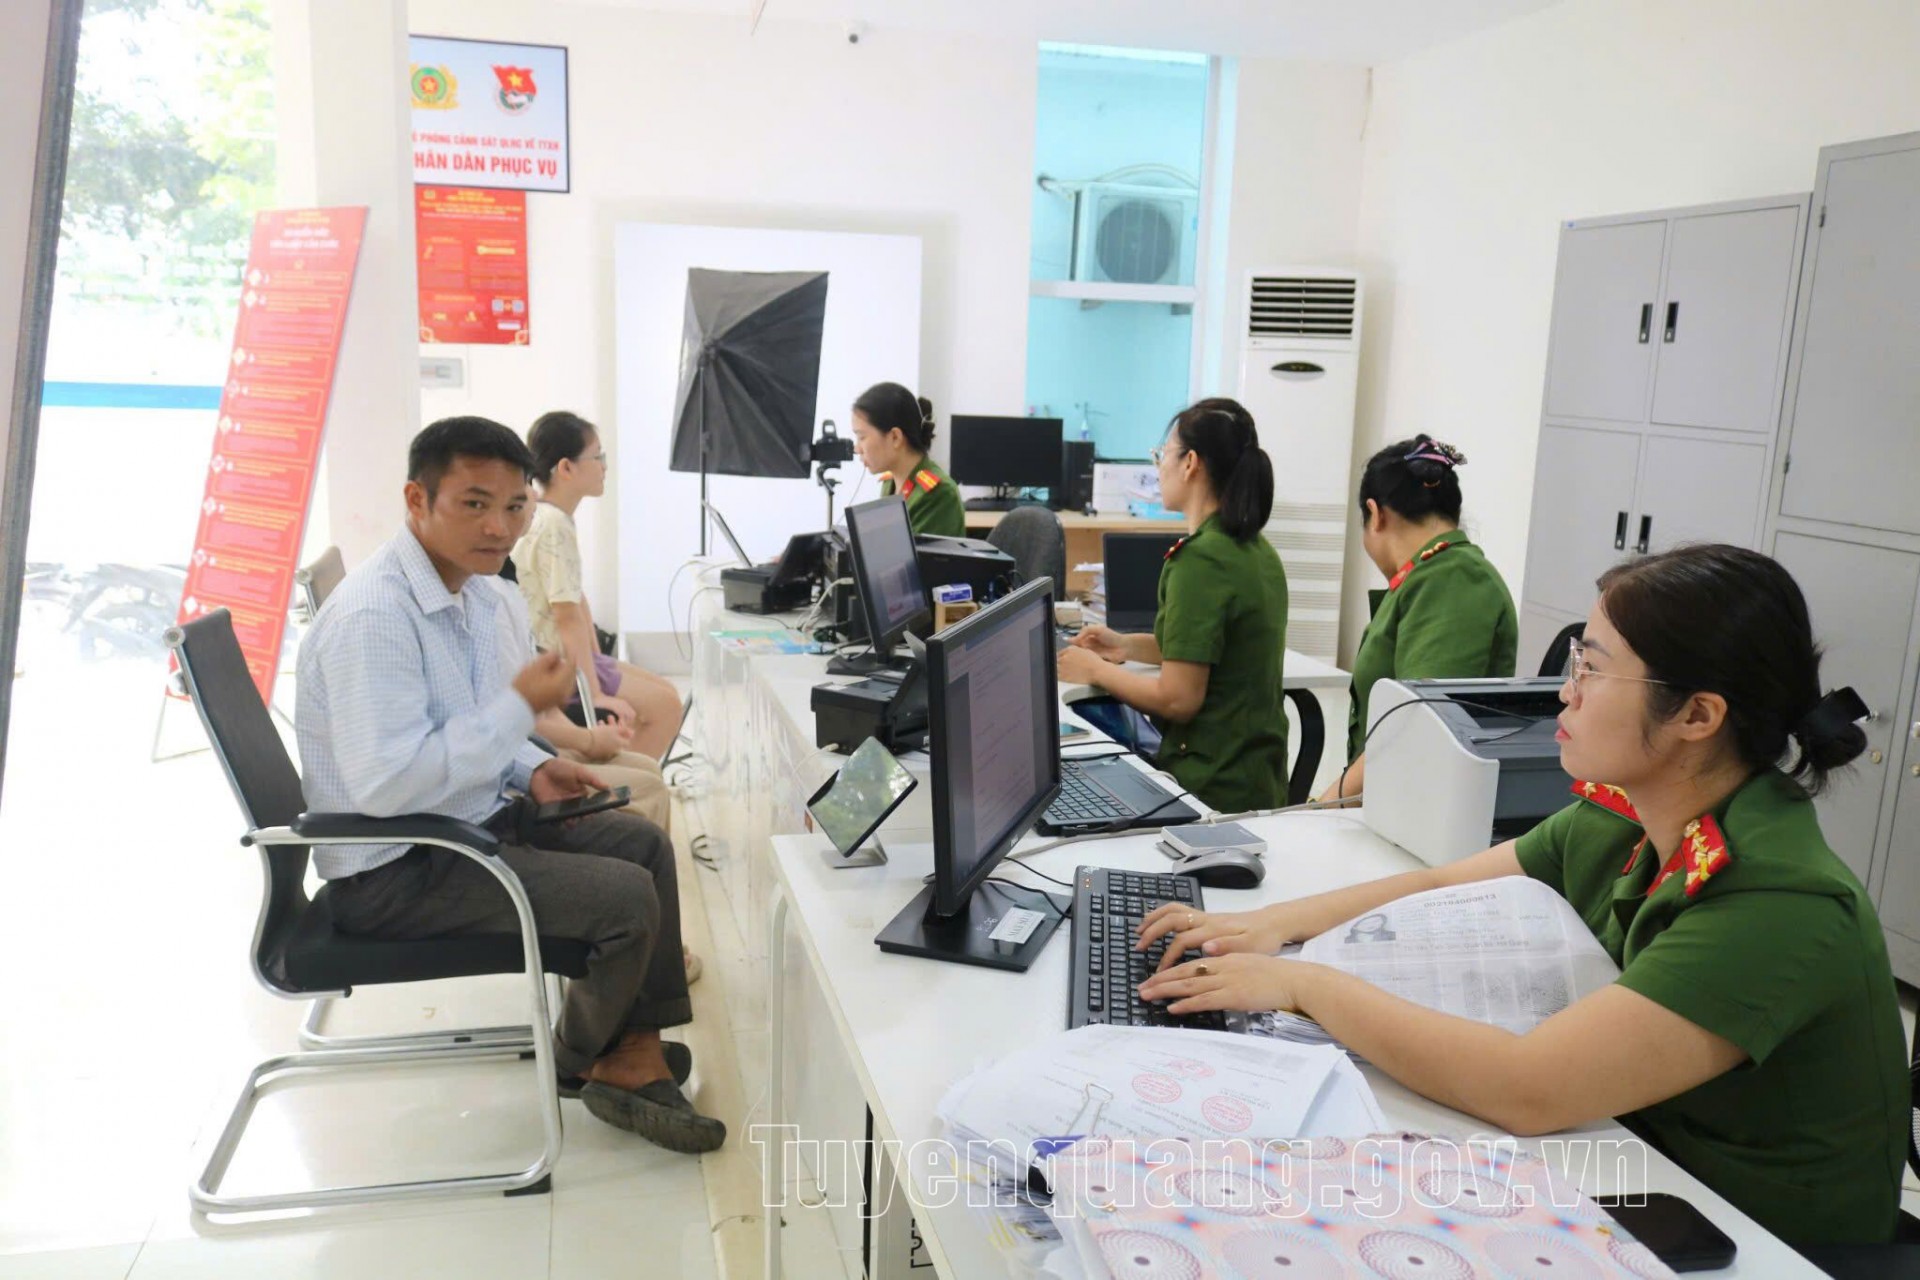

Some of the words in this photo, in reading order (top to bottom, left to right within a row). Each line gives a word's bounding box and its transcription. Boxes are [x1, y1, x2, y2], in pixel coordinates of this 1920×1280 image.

[453, 150, 485, 172] DÂN
[491, 155, 532, 178] PHỤC
[538, 158, 557, 179] VỤ
